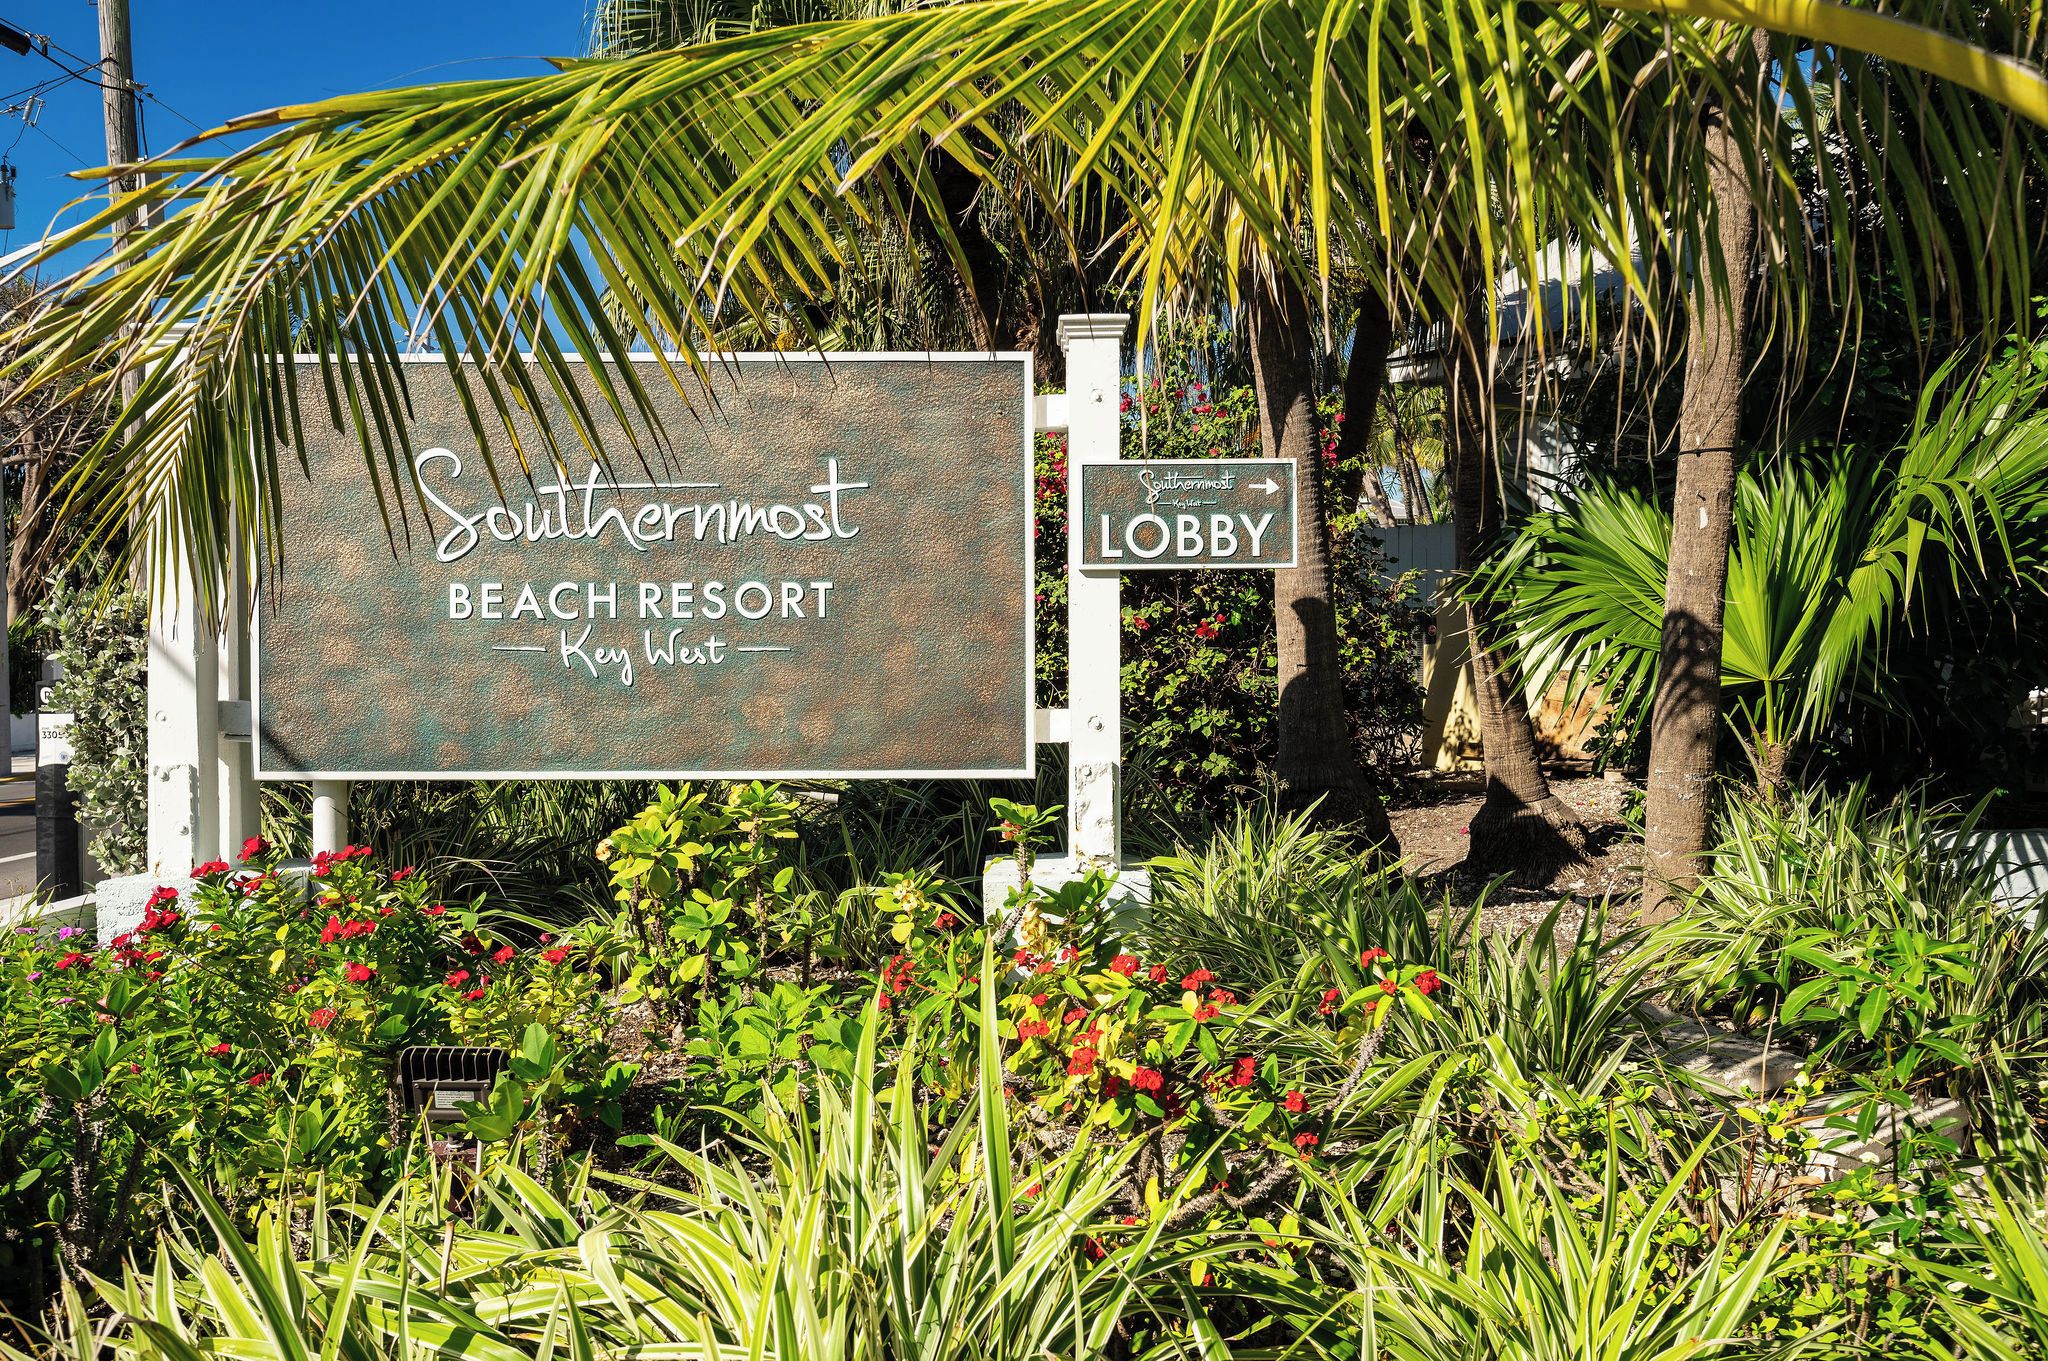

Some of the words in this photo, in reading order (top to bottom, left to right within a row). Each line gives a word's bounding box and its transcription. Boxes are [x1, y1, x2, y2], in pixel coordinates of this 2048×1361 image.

[415, 447, 869, 563] Southernmost
[1139, 469, 1236, 504] Southernmost
[1101, 513, 1274, 559] LOBBY
[449, 582, 619, 619] BEACH
[638, 581, 835, 619] RESORT
[560, 624, 634, 687] Key
[644, 628, 728, 665] West
